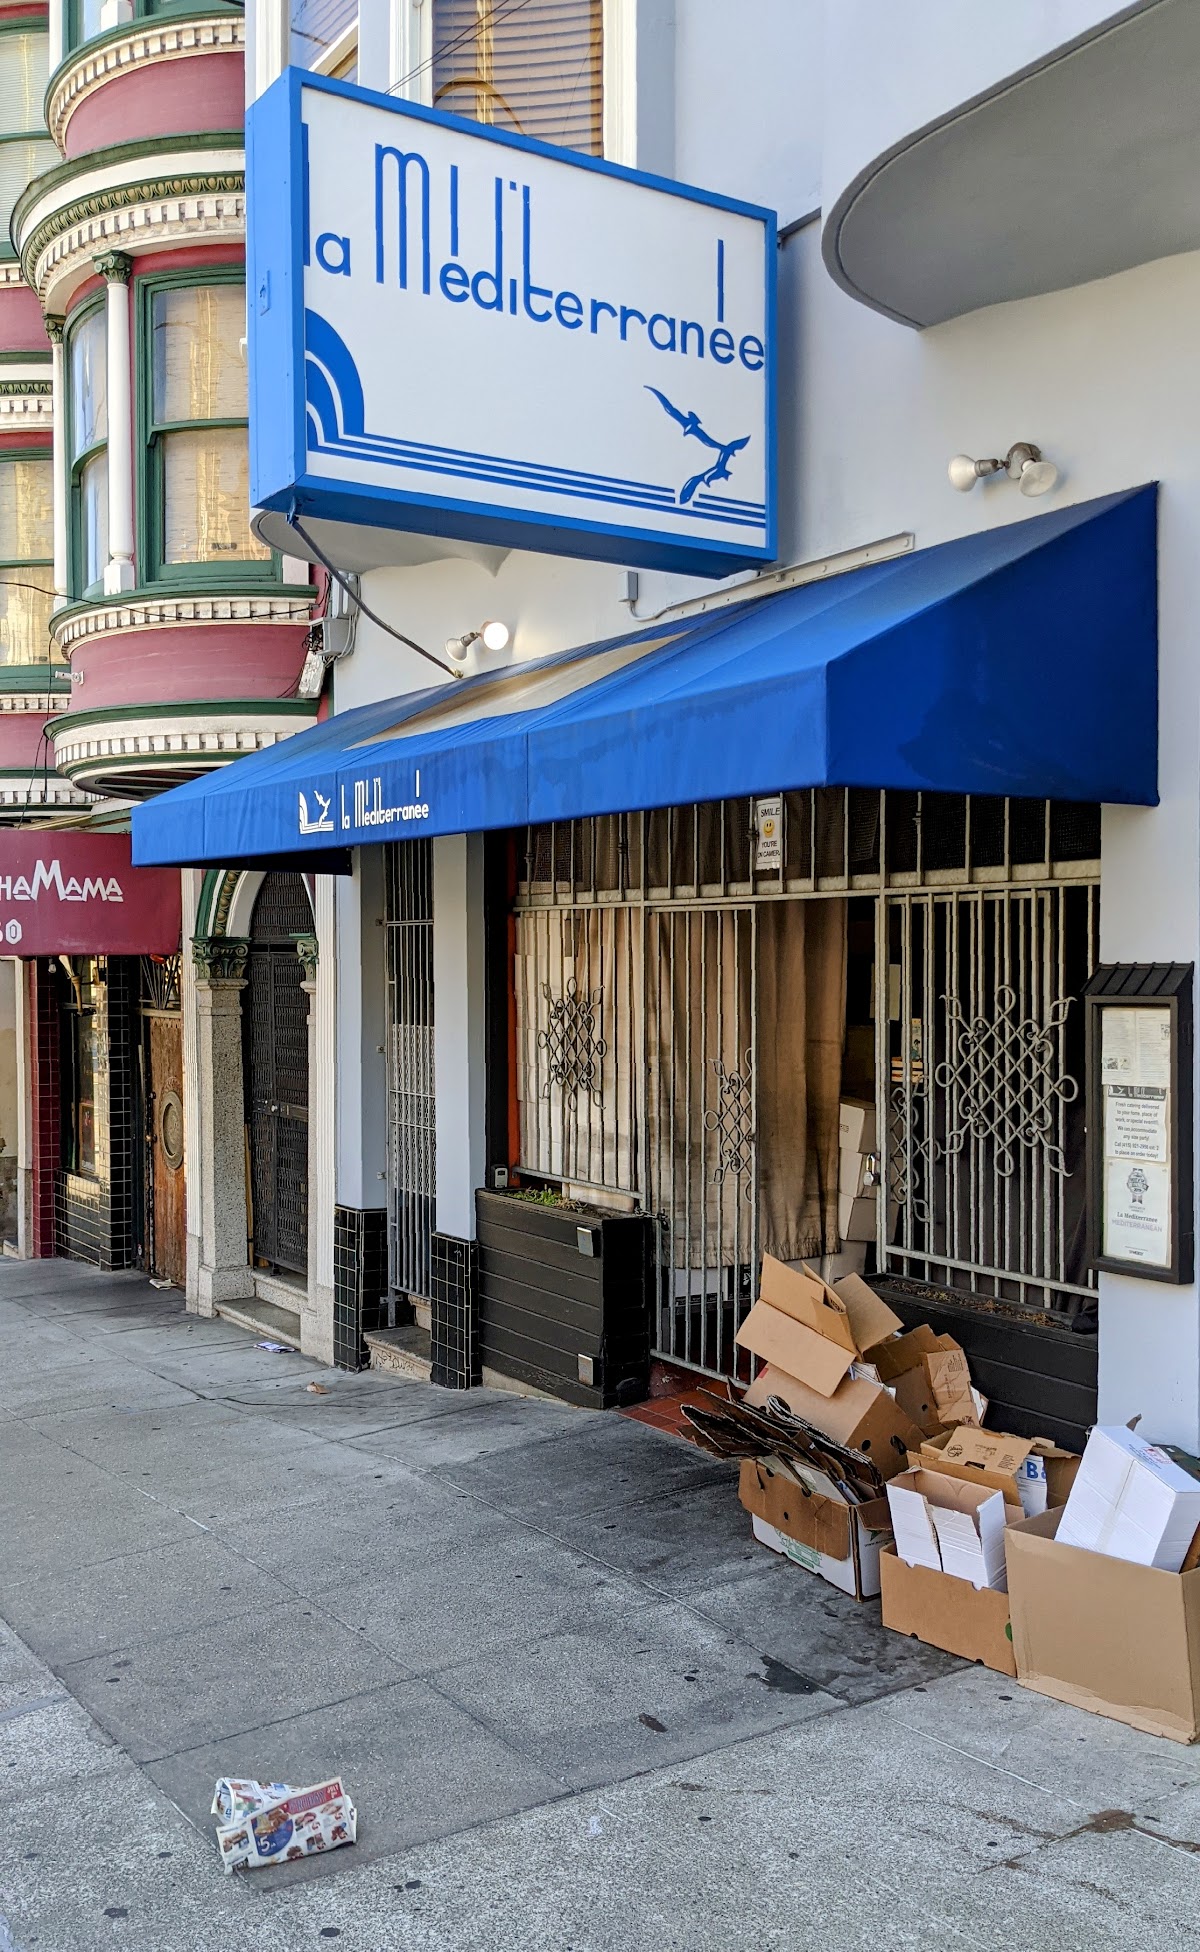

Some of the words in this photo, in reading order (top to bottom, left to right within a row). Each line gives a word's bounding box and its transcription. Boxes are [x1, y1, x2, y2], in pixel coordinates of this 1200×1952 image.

[760, 807, 780, 817] SMILE
[761, 840, 778, 848] YOU'RE
[763, 850, 780, 858] CAMER
[1111, 1219, 1162, 1232] MEDITERRANEAN
